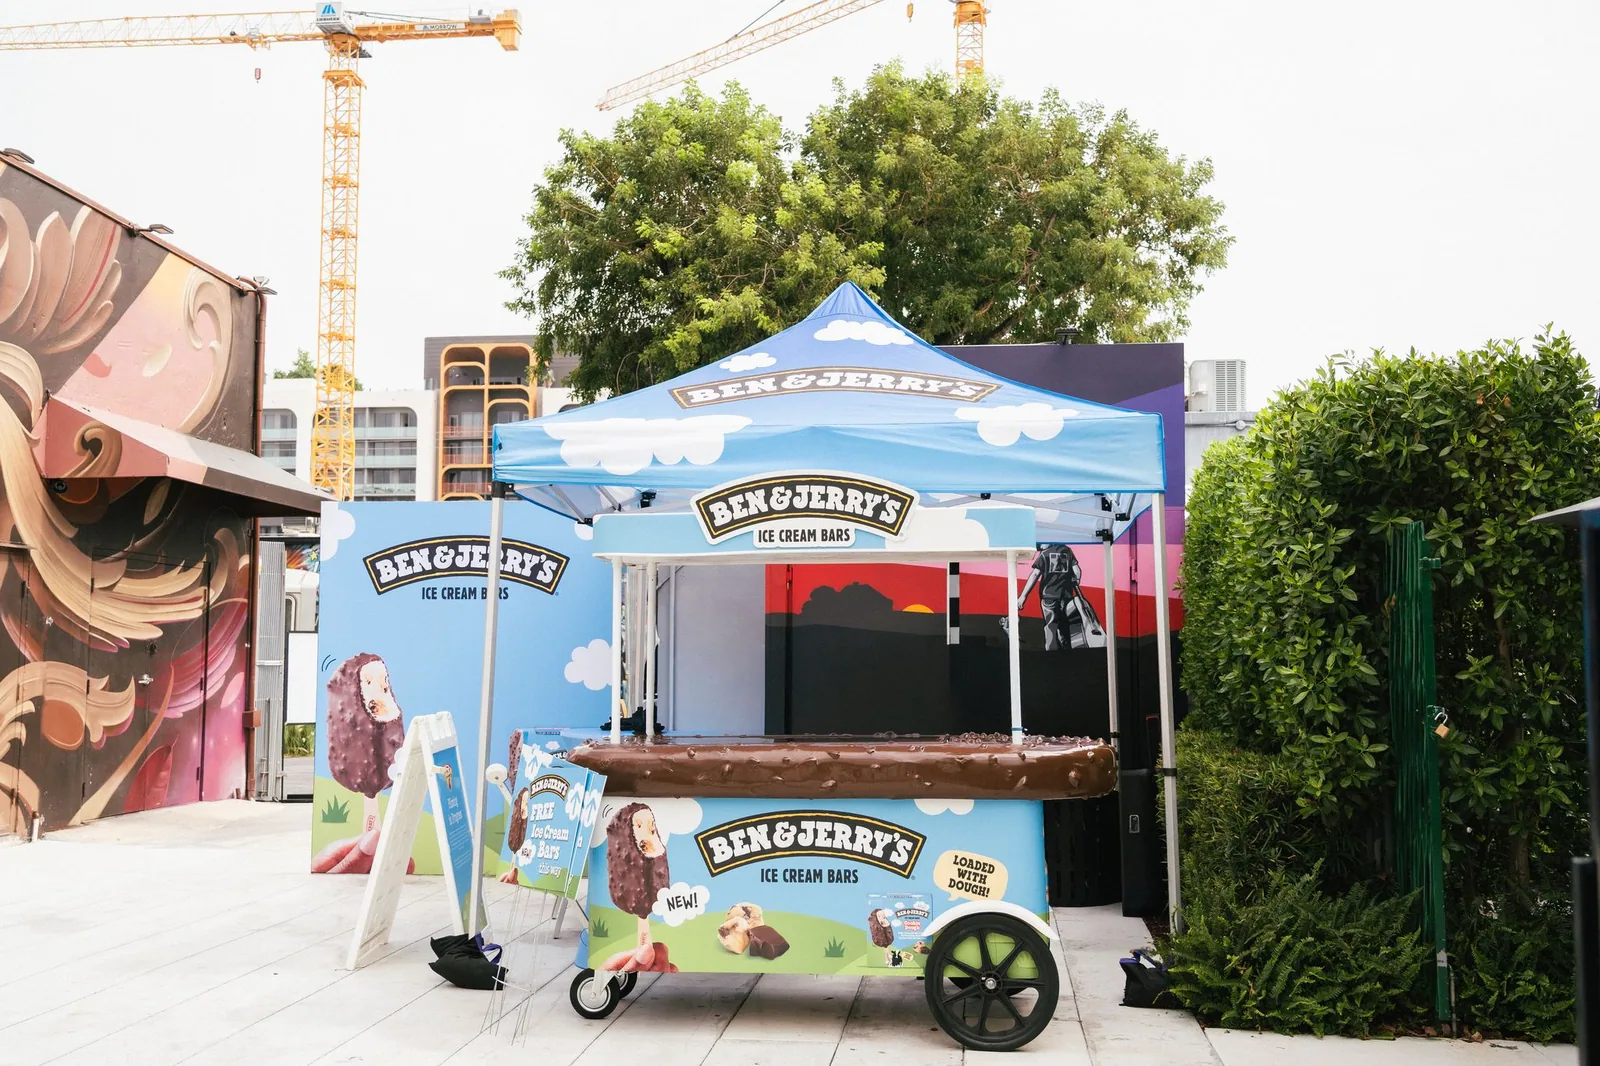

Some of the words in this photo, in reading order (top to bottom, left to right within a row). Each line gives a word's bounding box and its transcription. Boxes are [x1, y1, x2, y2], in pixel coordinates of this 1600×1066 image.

[687, 377, 778, 403] BEN
[781, 373, 817, 389] &
[816, 371, 984, 397] JERRY'S
[709, 488, 769, 527] BEN
[769, 486, 793, 511] &
[792, 484, 902, 524] JERRY'S
[758, 529, 775, 543] ICE
[779, 529, 817, 543] CREAM
[821, 528, 850, 542] BARS
[375, 547, 432, 584] BEN
[433, 545, 456, 569] &
[421, 587, 438, 600] ICE
[441, 587, 477, 600] CREAM
[480, 587, 509, 600] BRS
[530, 801, 556, 822] FREE
[531, 824, 543, 838] Ice
[544, 824, 570, 841] Cream
[537, 840, 561, 860] Bars
[708, 823, 772, 864] BEN
[772, 821, 798, 848] &
[797, 820, 914, 866] JERRY'S
[538, 862, 551, 874] this
[550, 866, 562, 878] way
[953, 854, 995, 875] LOADED
[760, 868, 779, 883] ICE
[782, 868, 823, 883] CREAM
[827, 868, 859, 884] BARS
[957, 868, 988, 885] WITH
[948, 878, 991, 898] DOUGH!
[666, 892, 699, 912] NEW!
